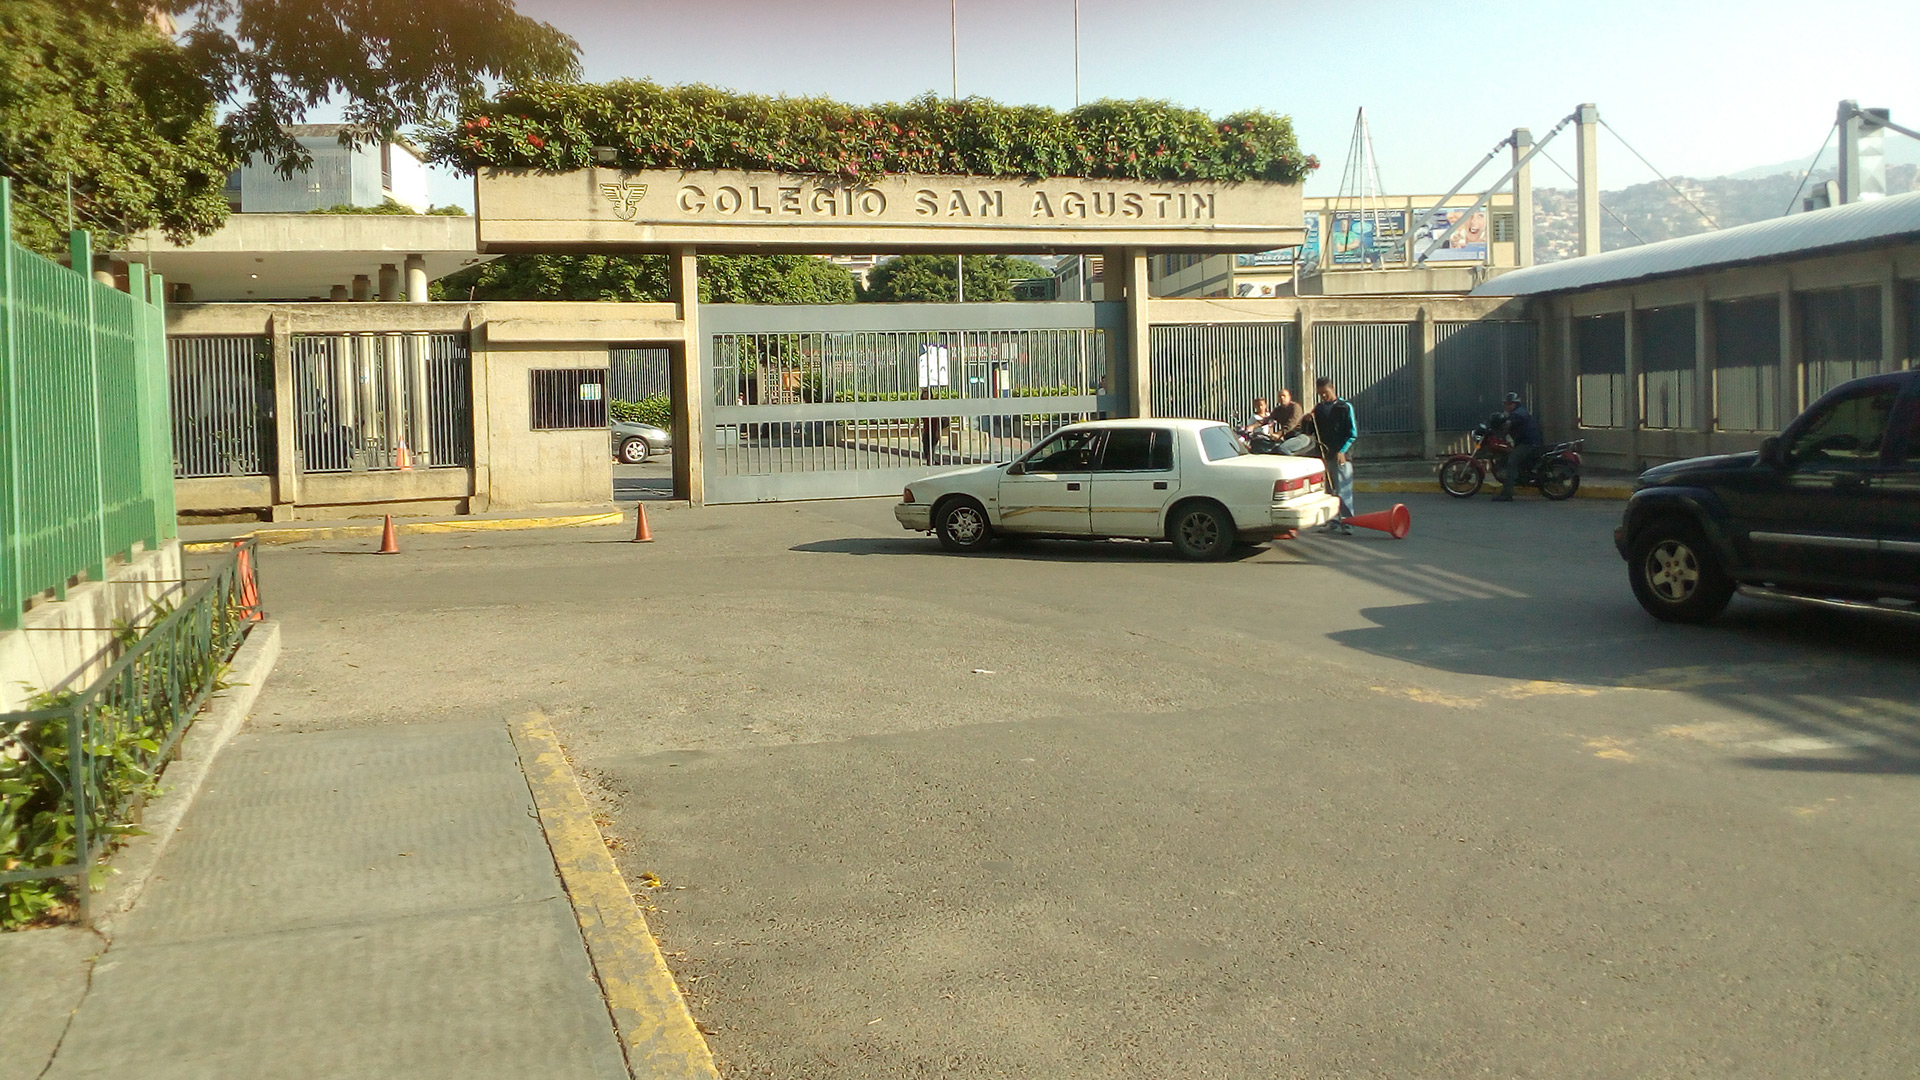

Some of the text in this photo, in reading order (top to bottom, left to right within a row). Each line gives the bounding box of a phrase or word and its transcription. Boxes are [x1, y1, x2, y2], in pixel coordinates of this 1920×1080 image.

[677, 184, 1215, 219] COLEGIO SAN AGUSTIN
